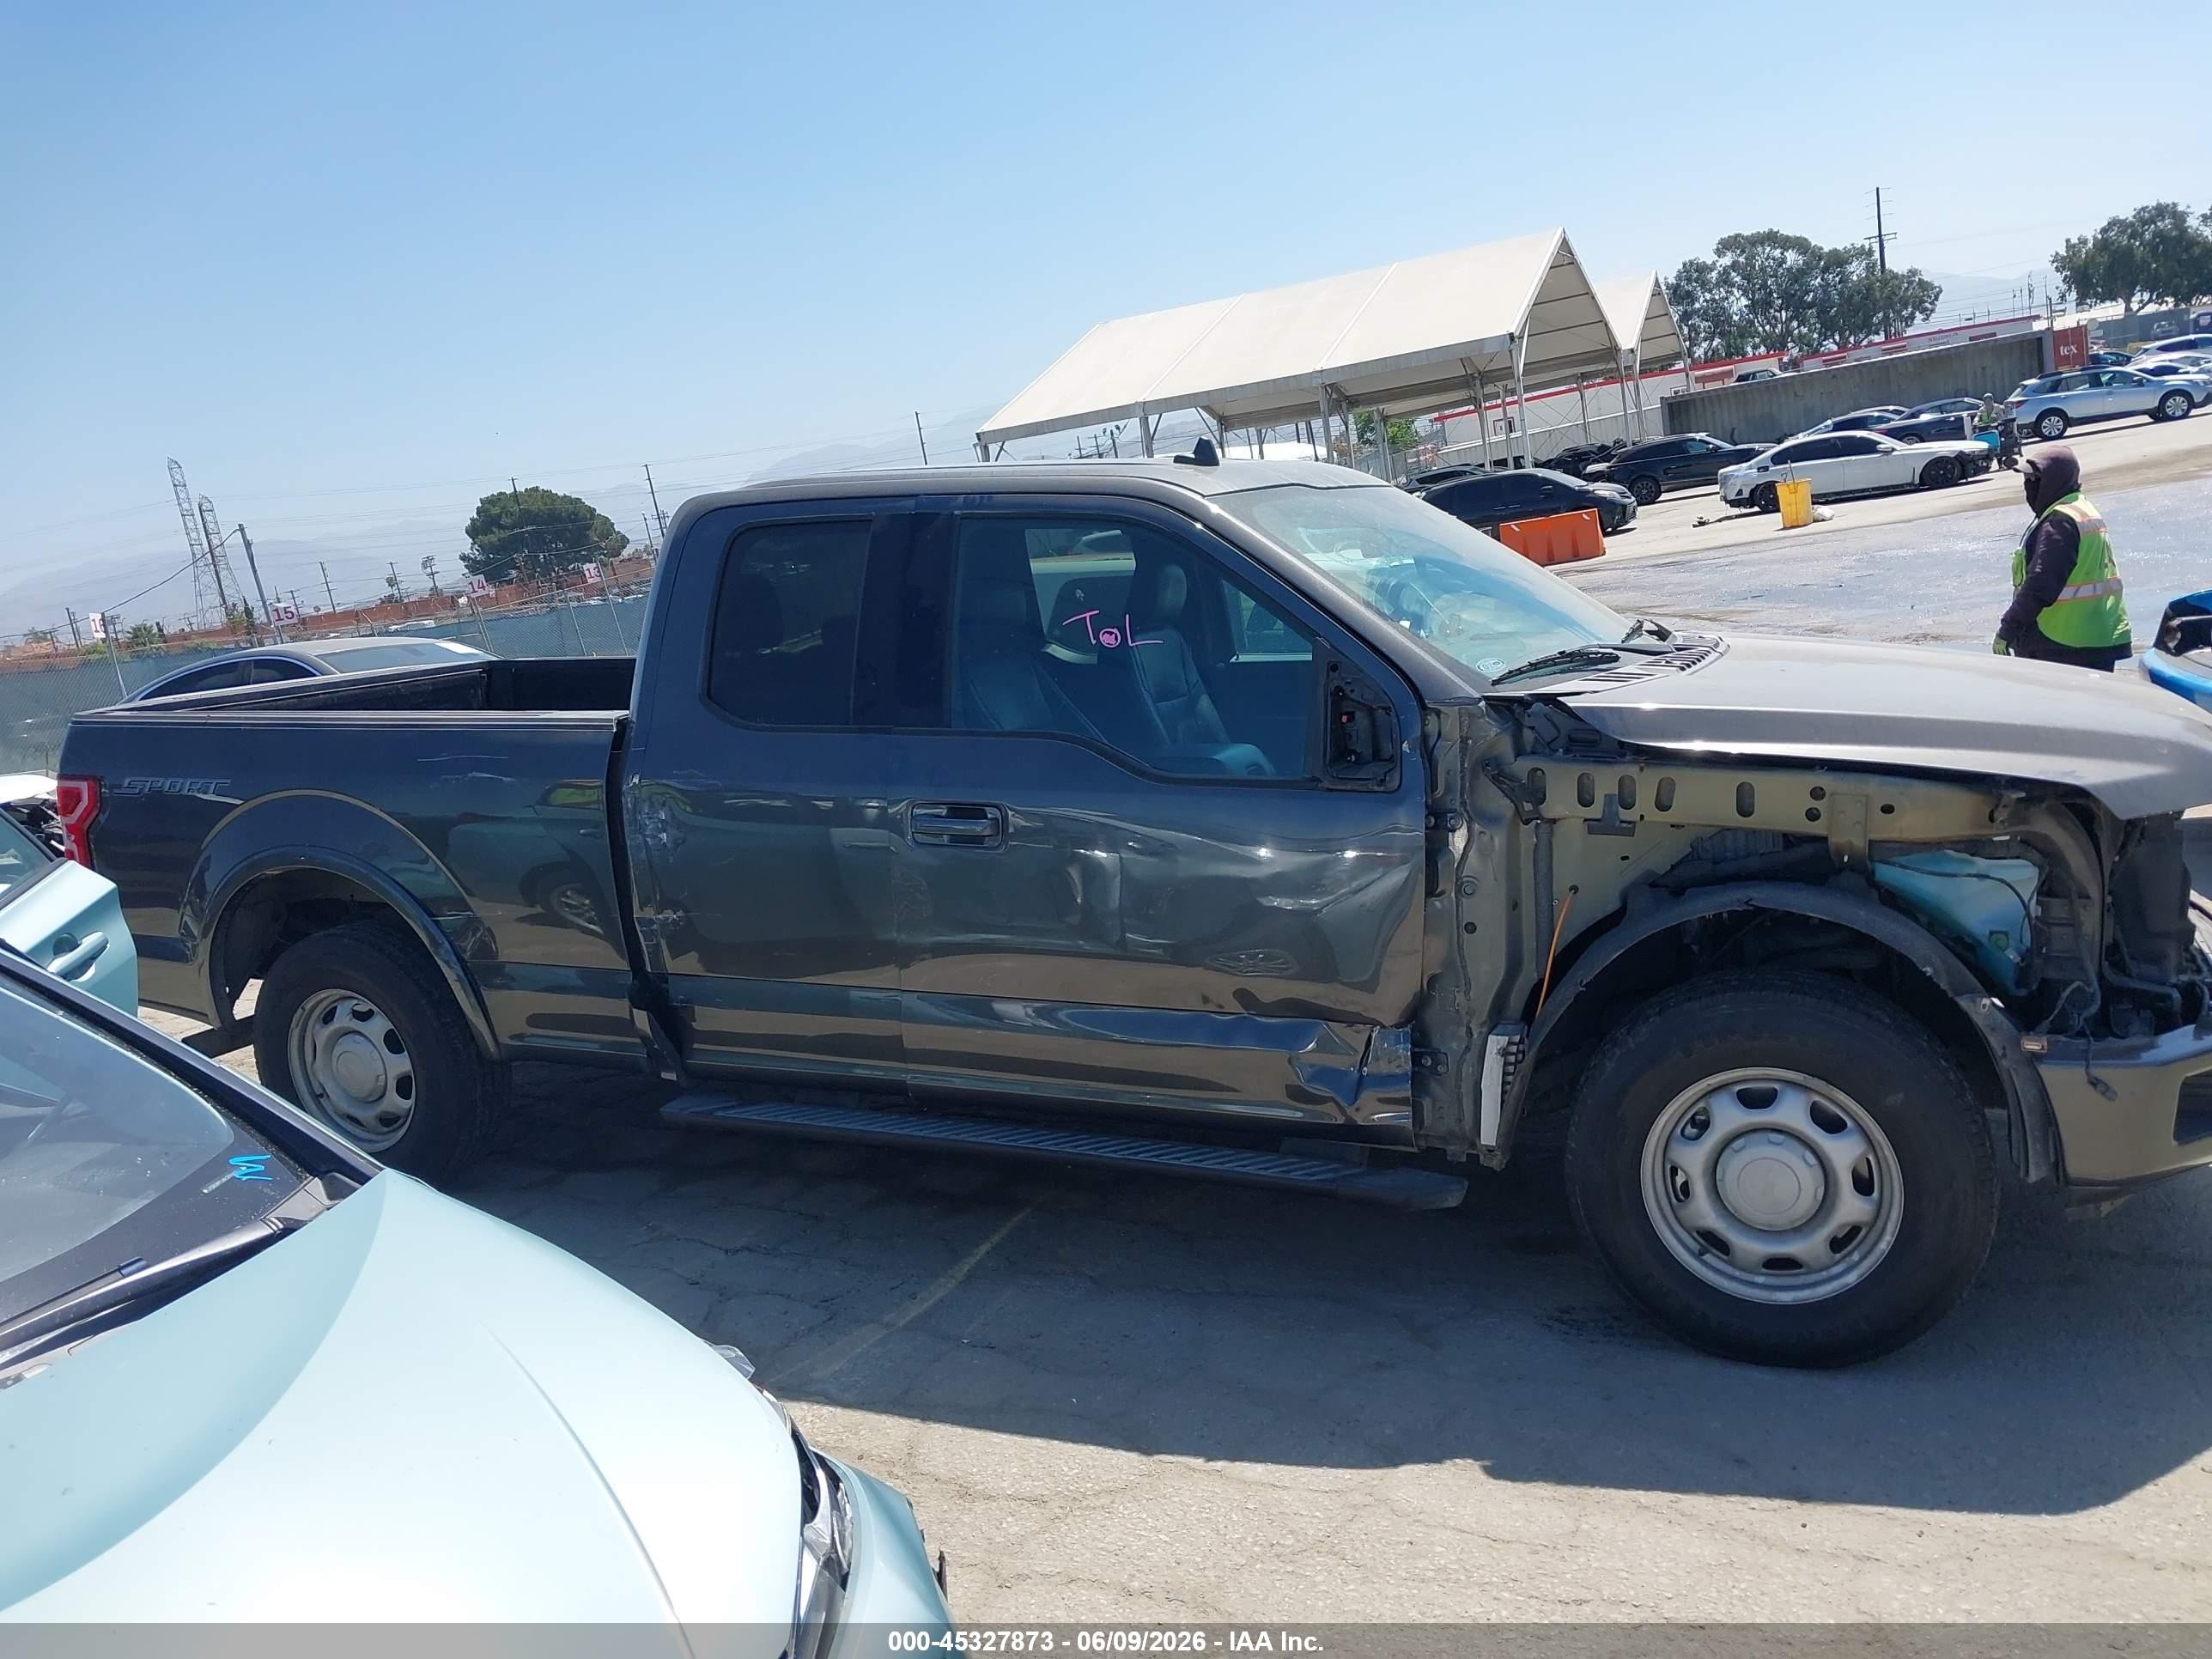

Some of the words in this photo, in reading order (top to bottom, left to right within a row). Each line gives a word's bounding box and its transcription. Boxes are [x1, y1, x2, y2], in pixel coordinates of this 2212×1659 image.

[2059, 343, 2078, 356] tex
[468, 579, 486, 593] 14
[272, 605, 295, 622] 15
[112, 777, 233, 797] SPORT
